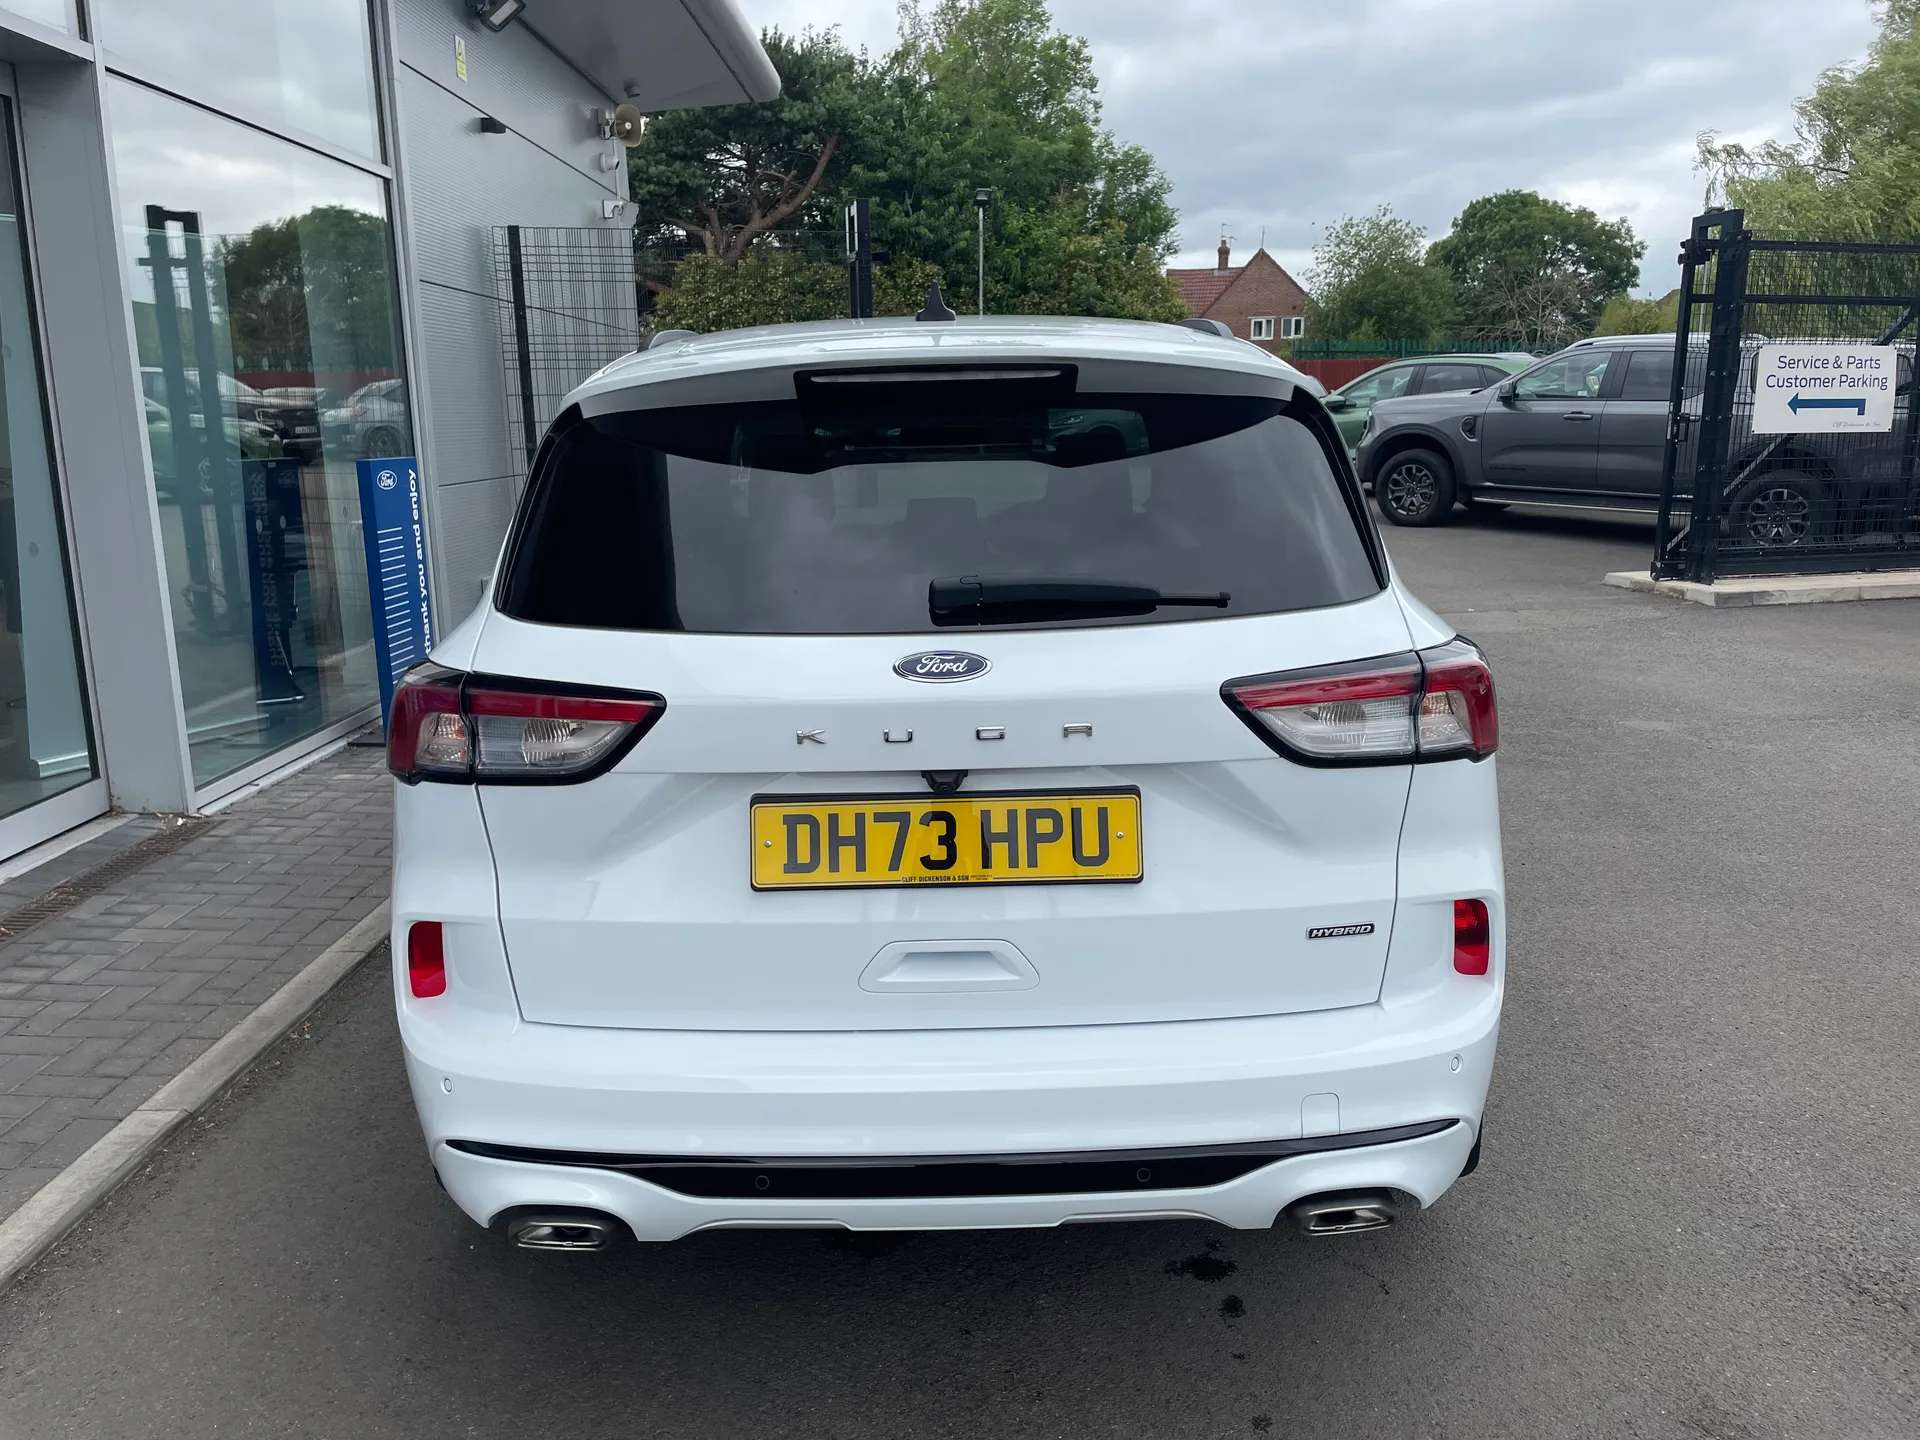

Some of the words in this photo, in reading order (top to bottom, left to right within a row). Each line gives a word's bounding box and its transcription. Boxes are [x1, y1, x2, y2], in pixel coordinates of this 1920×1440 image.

[1777, 355, 1829, 369] Service
[1833, 355, 1843, 369] &
[1847, 355, 1881, 369] Parts
[1766, 374, 1836, 388] Customer
[1839, 374, 1888, 391] Parking
[408, 468, 418, 521] enjoy
[413, 524, 423, 560] and
[418, 564, 428, 598] you
[420, 601, 431, 654] thank
[916, 655, 968, 673] Ford
[796, 722, 1093, 745] KUGA
[783, 811, 957, 873] DH73
[980, 807, 1109, 869] HPU
[1310, 925, 1372, 938] HYBRID
